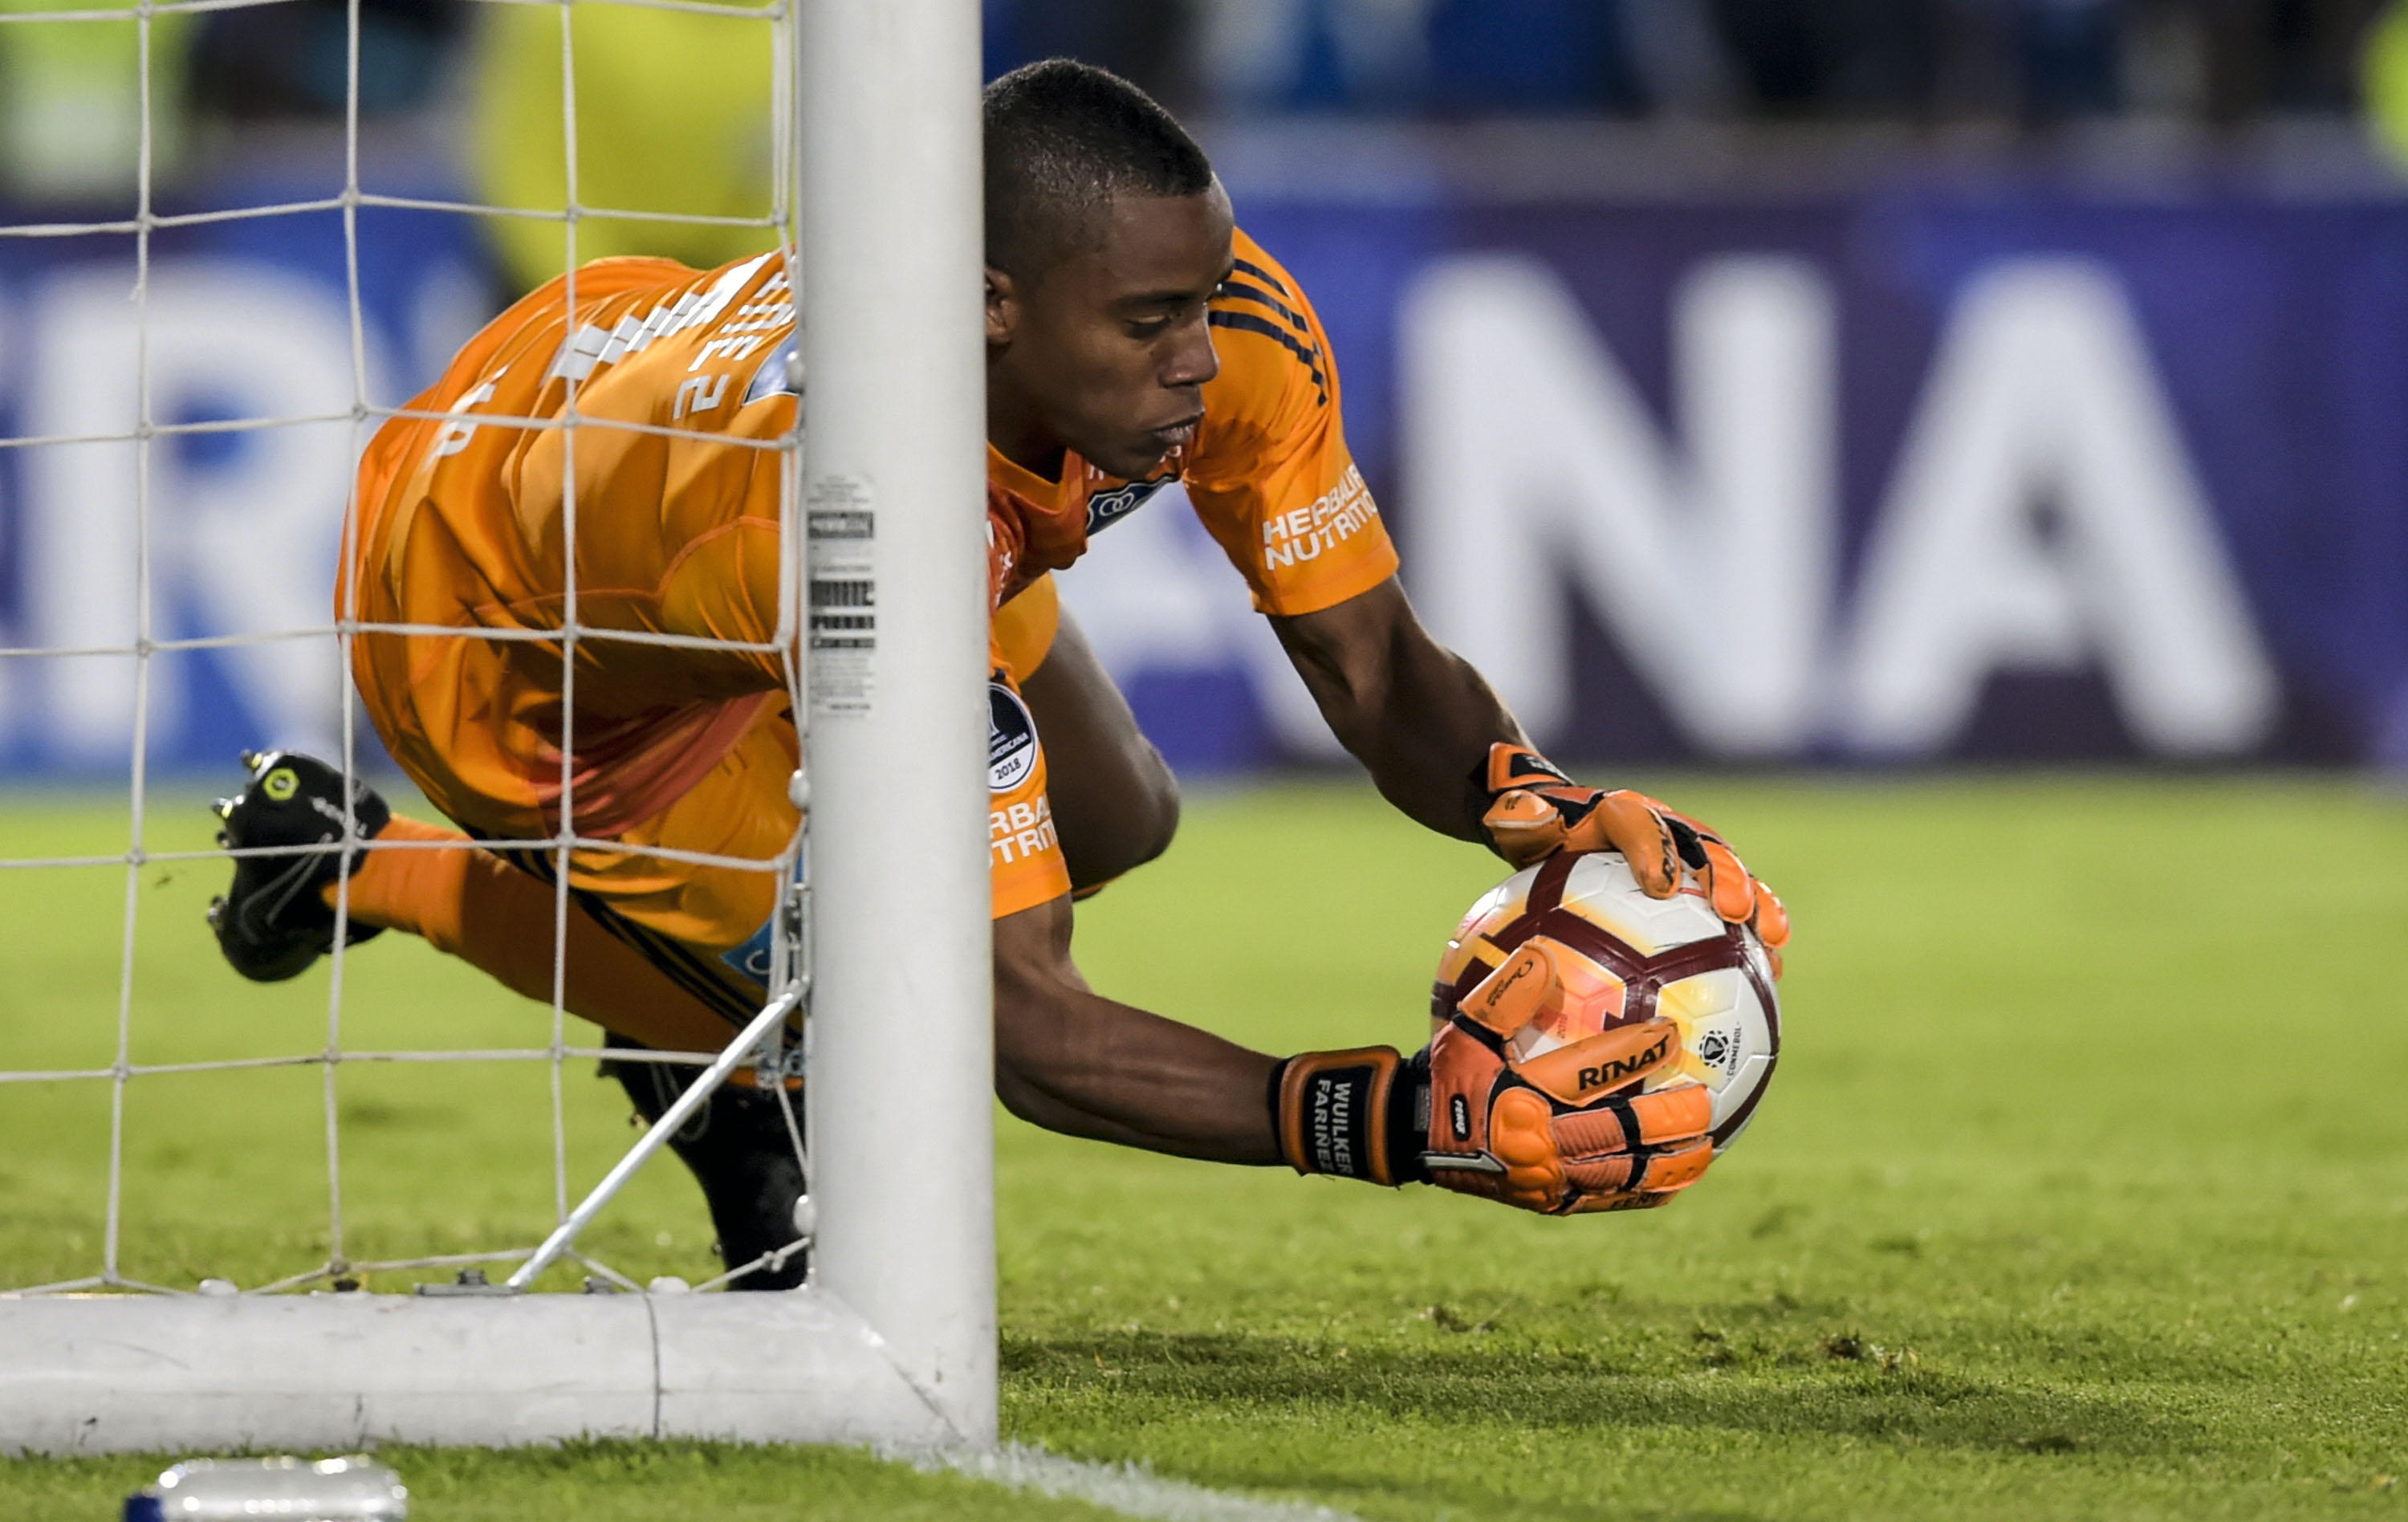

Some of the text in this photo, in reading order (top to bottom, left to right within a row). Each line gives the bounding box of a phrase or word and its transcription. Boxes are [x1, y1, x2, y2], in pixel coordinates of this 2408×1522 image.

[995, 758, 1022, 780] 2018
[1579, 1034, 1670, 1091] RINAT
[1727, 1025, 1742, 1076] CONMEBOL
[1332, 1082, 1354, 1174] WUILKER
